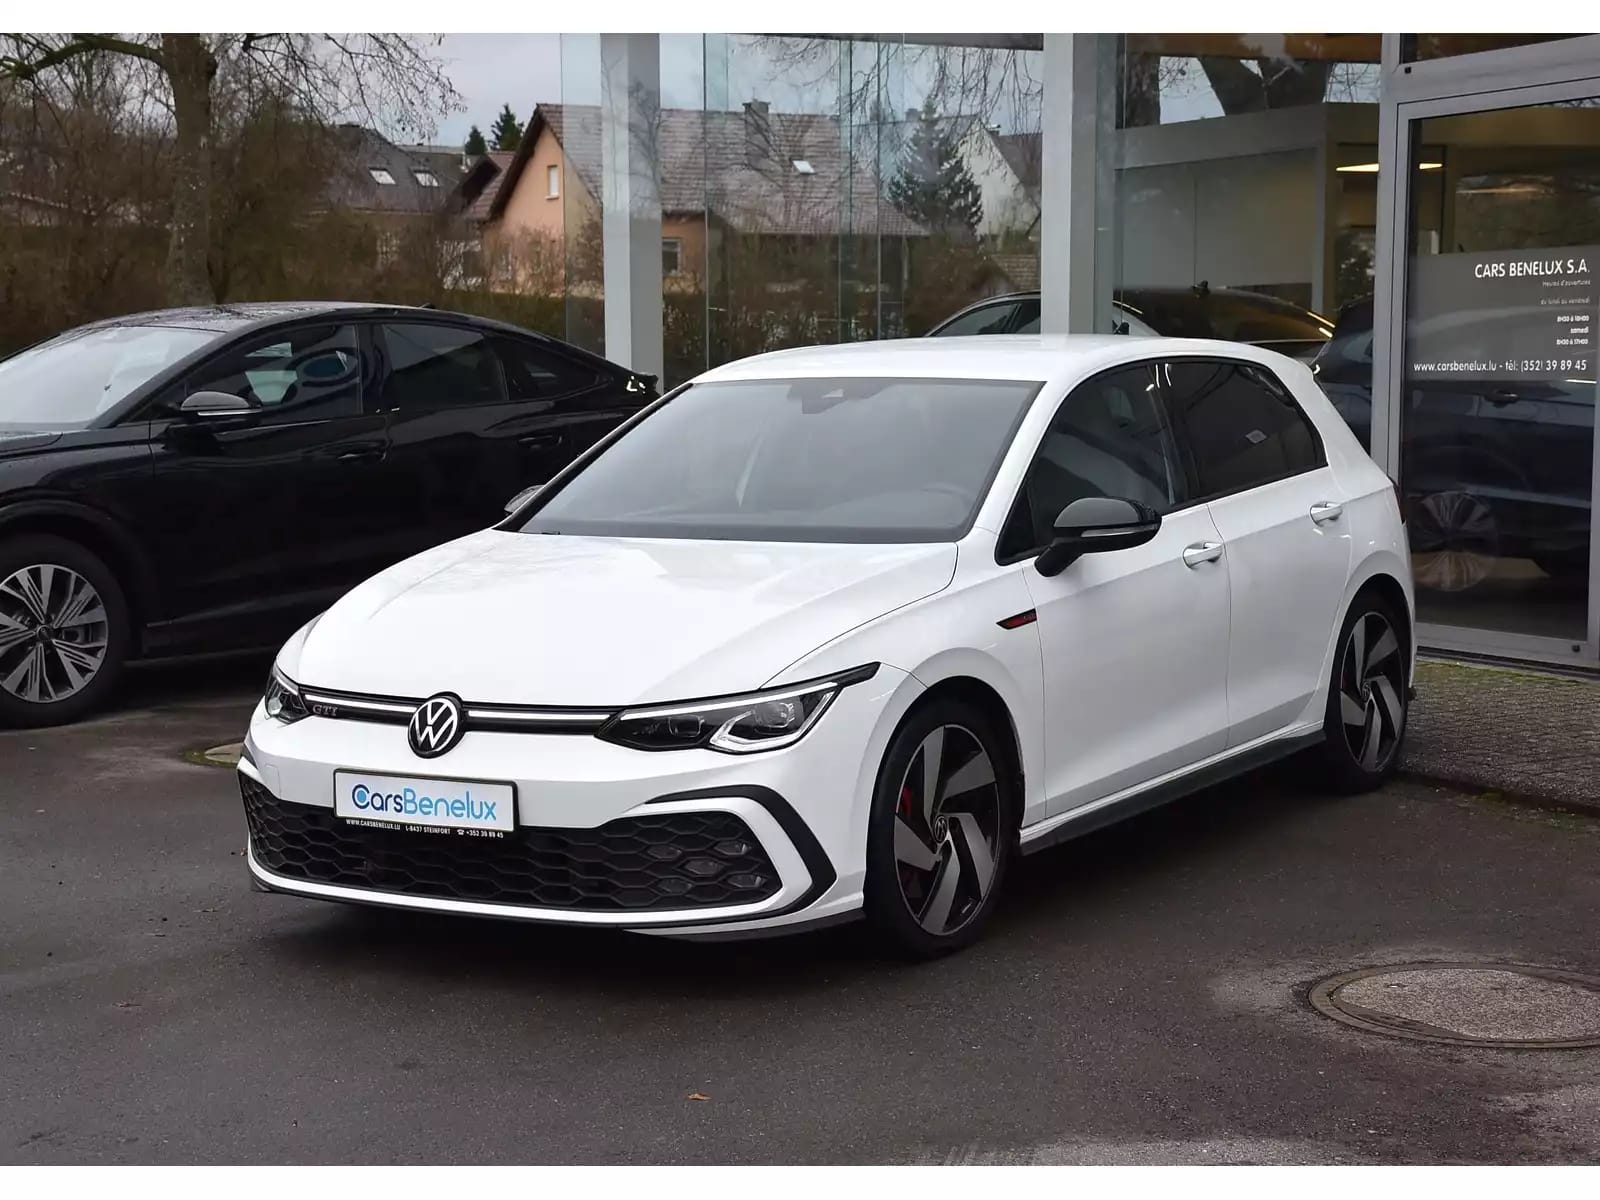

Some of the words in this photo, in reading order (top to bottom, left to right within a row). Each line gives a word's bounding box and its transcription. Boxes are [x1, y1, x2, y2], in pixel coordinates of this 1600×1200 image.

[1474, 262, 1506, 278] CARS
[1509, 260, 1563, 277] BENELUX
[1566, 258, 1590, 274] S.A.
[1413, 359, 1497, 372] www.carsbenelux.lu
[1545, 359, 1558, 371] 39
[1560, 359, 1572, 371] 89
[1574, 359, 1587, 371] 45
[312, 704, 338, 717] GTI
[351, 783, 497, 821] CarsBenelux
